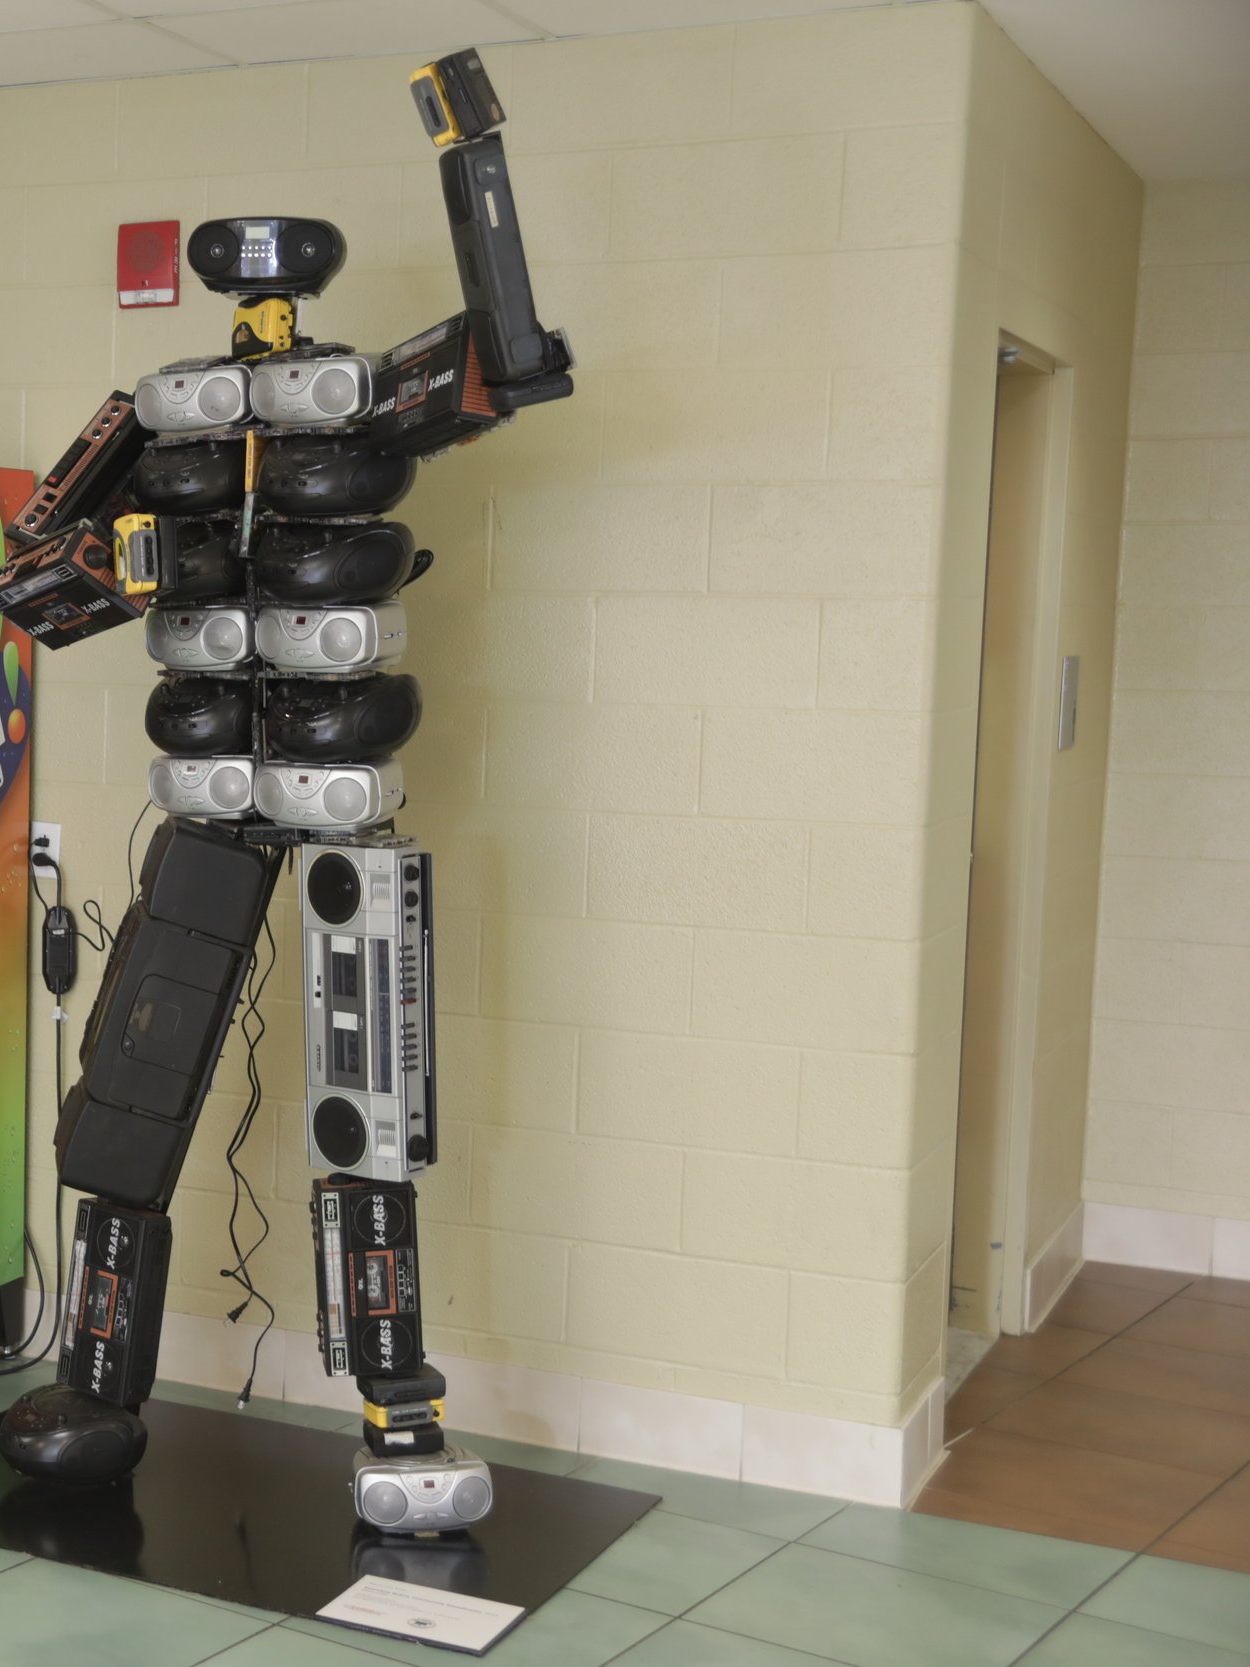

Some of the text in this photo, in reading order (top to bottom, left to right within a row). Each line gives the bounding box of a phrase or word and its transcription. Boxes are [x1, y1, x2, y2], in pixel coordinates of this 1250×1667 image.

[428, 369, 454, 392] X-BASS
[372, 397, 396, 418] X-BASS
[80, 597, 110, 615] X-BASS
[28, 620, 54, 636] X-BASS
[373, 1194, 387, 1246] X-BASS
[106, 1217, 121, 1270] X-BASS
[380, 1319, 393, 1370] X-BASS
[91, 1341, 105, 1394] X-BASS
